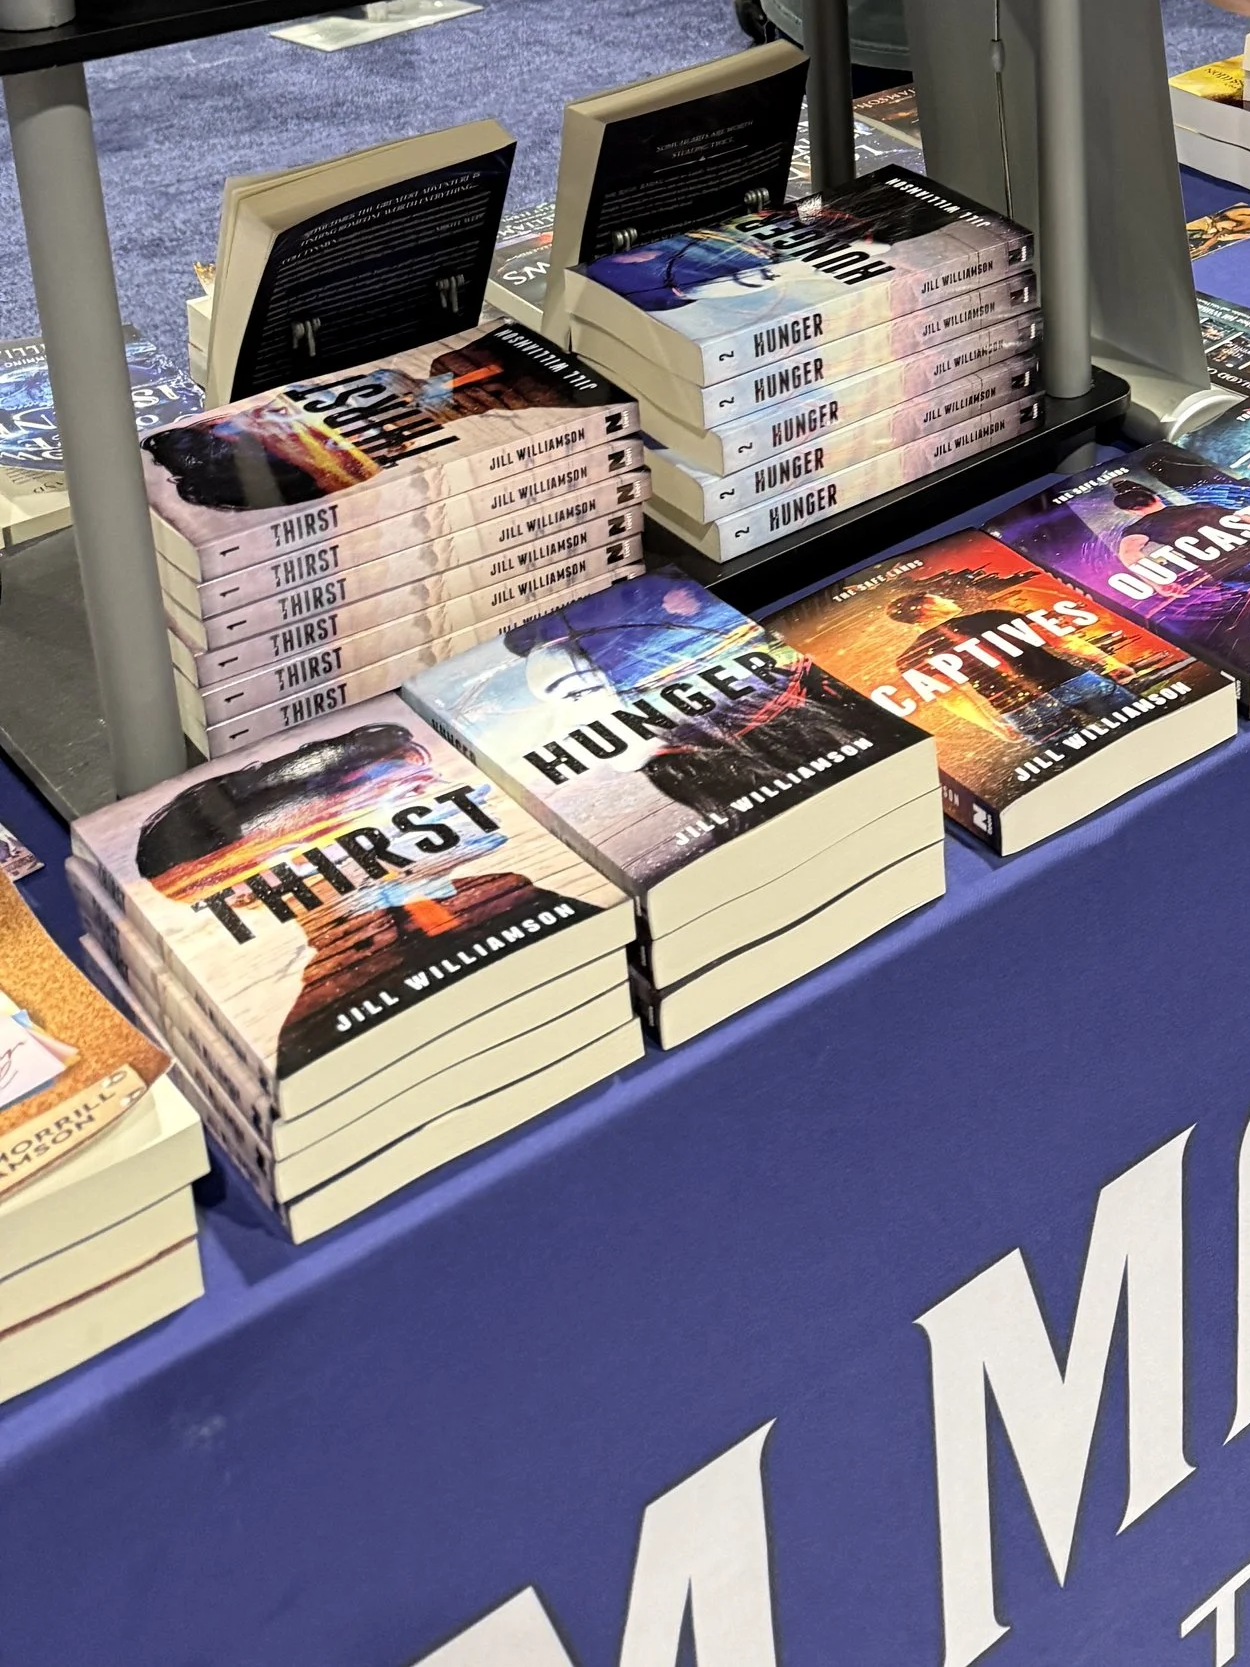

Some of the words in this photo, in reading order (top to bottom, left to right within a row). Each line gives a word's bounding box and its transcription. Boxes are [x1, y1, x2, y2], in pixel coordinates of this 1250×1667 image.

[885, 176, 960, 215] WILLIAMSON
[955, 207, 992, 228] JILL
[736, 212, 898, 287] HUNGER
[494, 326, 566, 373] WILLIAMSON
[753, 313, 824, 358] HUNGER
[921, 279, 940, 294] JILL
[941, 260, 994, 286] WILLIAMSON
[753, 357, 825, 402] HUNGER
[922, 321, 941, 336] JILL
[943, 301, 996, 329] WILLIAMSON
[285, 375, 461, 468] THIRST
[562, 361, 598, 392] JILL
[771, 400, 839, 448] HUNGER
[933, 360, 951, 376] JILL
[271, 504, 339, 547] THIRST
[489, 452, 514, 471] JILL
[516, 427, 586, 462] WILLIAMSON
[754, 447, 825, 494] HUNGER
[923, 407, 942, 424] JILL
[944, 387, 997, 415] WILLIAMSON
[768, 483, 838, 532] HUNGER
[933, 441, 952, 458] JILL
[954, 419, 1006, 449] WILLIAMSON
[1053, 488, 1079, 506] THE
[1074, 478, 1101, 497] SAFE
[1097, 465, 1130, 487] LANDS
[271, 544, 340, 588] THIRST
[491, 490, 516, 509] JILL
[518, 465, 588, 500] WILLIAMSON
[278, 578, 347, 620] THIRST
[498, 524, 524, 543] JILL
[526, 498, 597, 533] WILLIAMSON
[269, 613, 339, 657] THIRST
[490, 557, 515, 576] JILL
[517, 531, 588, 567] WILLIAMSON
[274, 646, 342, 692] THIRST
[491, 588, 515, 607] JILL
[518, 559, 586, 596] WILLIAMSON
[832, 585, 861, 604] THE
[859, 573, 889, 595] SAFE
[885, 557, 924, 581] LANDS
[280, 682, 348, 727] THIRST
[869, 599, 1099, 721] CAPTIVES
[520, 648, 782, 787] HUNGER
[1014, 744, 1062, 784] JILL
[1063, 679, 1192, 752] WILLIAMSON
[673, 809, 724, 849] JILL
[729, 736, 876, 816] WILLIAMSON
[191, 783, 502, 946] THIRST
[334, 990, 400, 1034] JILL
[403, 901, 576, 992] WILLIAMSON
[0, 1114, 97, 1180] AMSON
